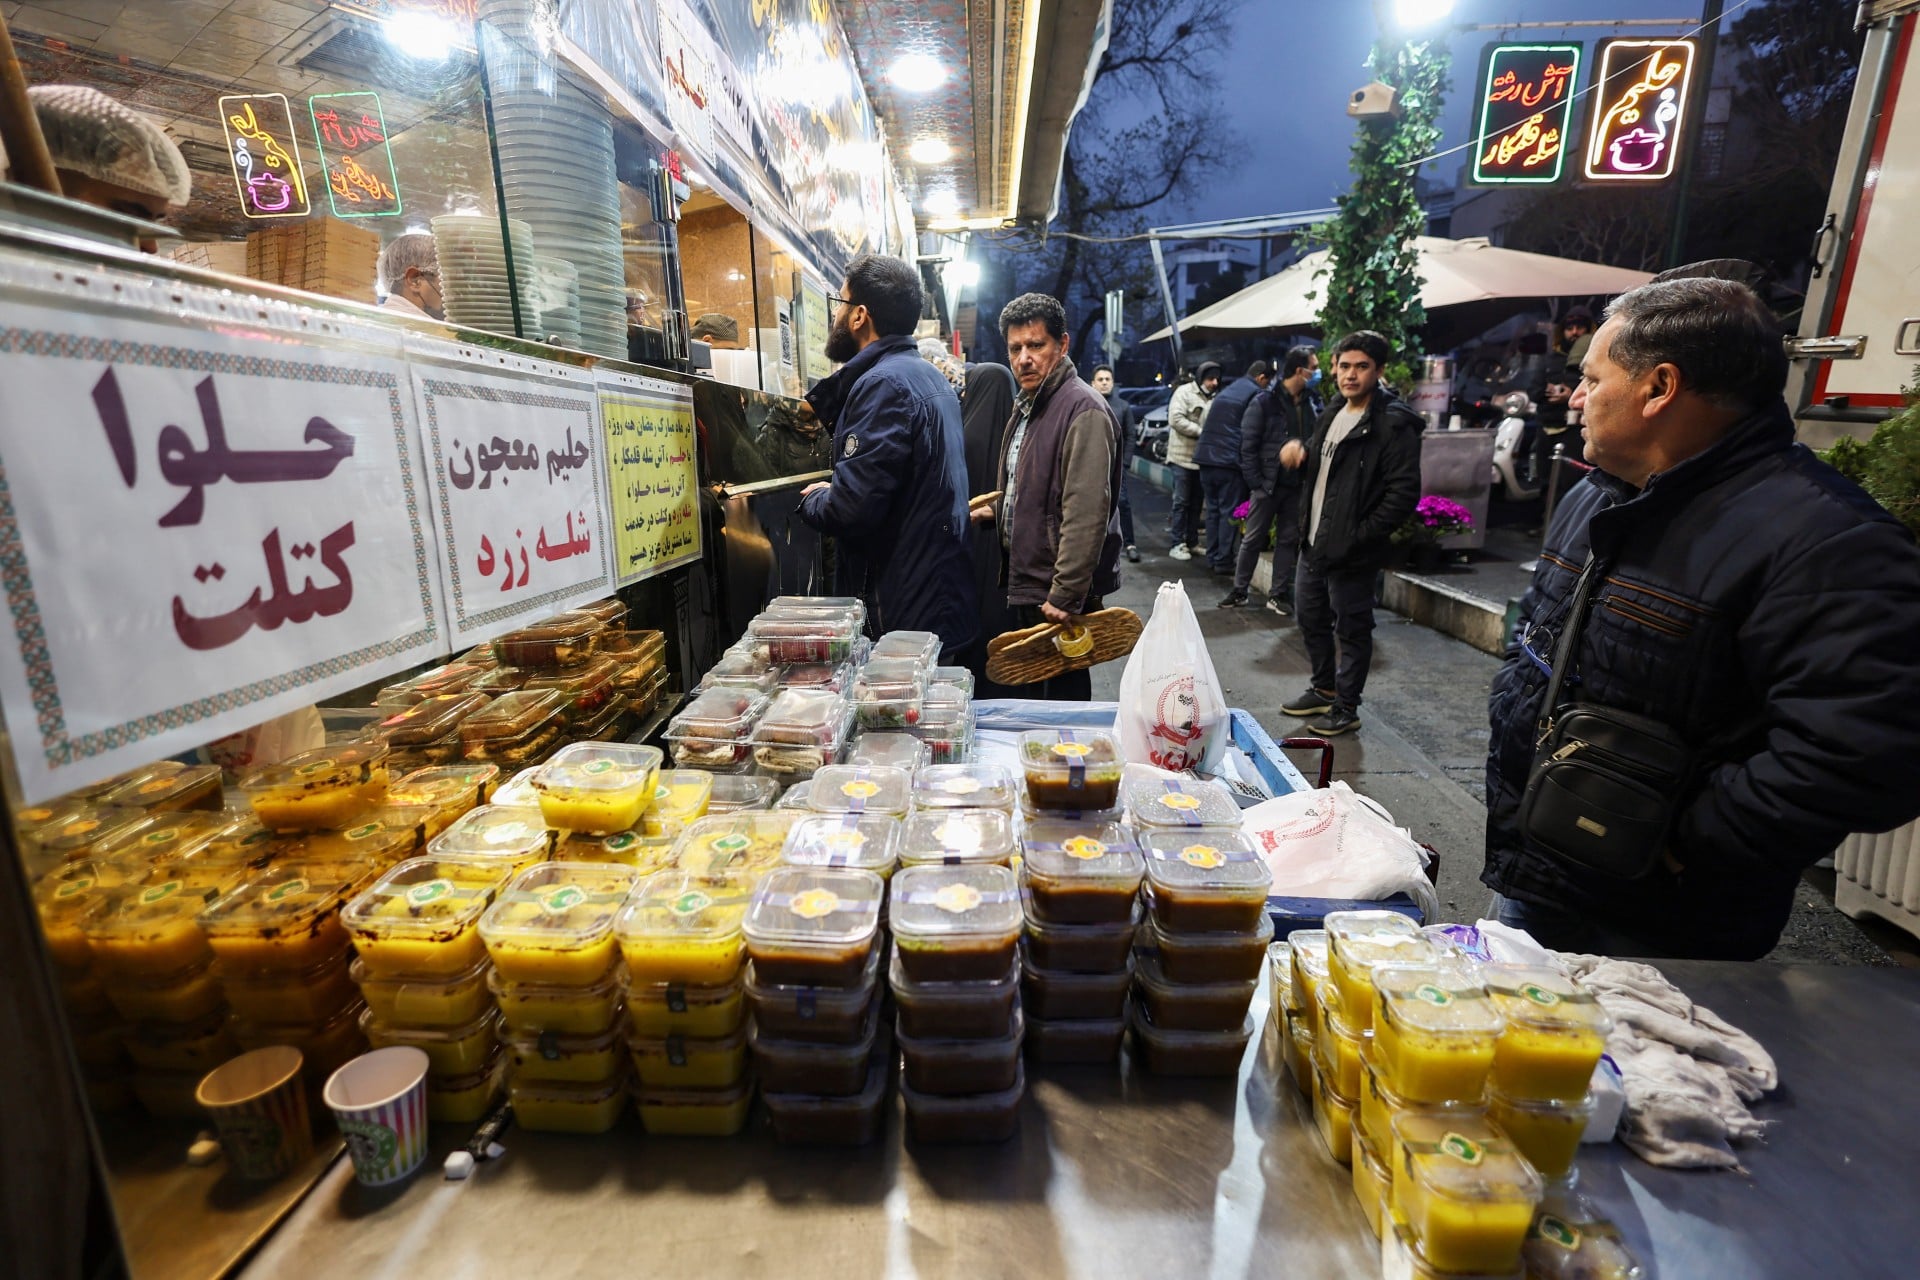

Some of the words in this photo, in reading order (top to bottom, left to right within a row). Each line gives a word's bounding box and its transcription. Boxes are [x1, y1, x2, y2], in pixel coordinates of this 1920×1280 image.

[1488, 70, 1522, 102] رشته
[1521, 63, 1574, 106] آش
[1592, 49, 1682, 165] حلیم
[1480, 113, 1544, 166] قلمکار
[1522, 127, 1560, 166] شله
[608, 417, 623, 436] روزه
[624, 418, 635, 431] همه
[636, 415, 657, 437] رمضان
[658, 417, 675, 438] مبارک
[675, 418, 684, 433] ماه
[685, 421, 691, 438] در
[91, 364, 356, 528] حلوا
[546, 425, 589, 486] حلیم
[642, 446, 653, 464] شله
[654, 445, 665, 469] آش
[449, 435, 540, 490] معجون
[675, 474, 685, 496] آش
[625, 511, 645, 532] خدمت
[672, 508, 682, 525] زرد
[682, 503, 692, 518] شله
[647, 513, 654, 532] در
[536, 510, 591, 562] شله
[662, 532, 683, 556] مشتریان
[682, 530, 692, 546] شما
[477, 528, 530, 592] زرد
[630, 545, 648, 568] هستیم
[649, 541, 661, 562] عزیز
[171, 520, 356, 651] کتلت
